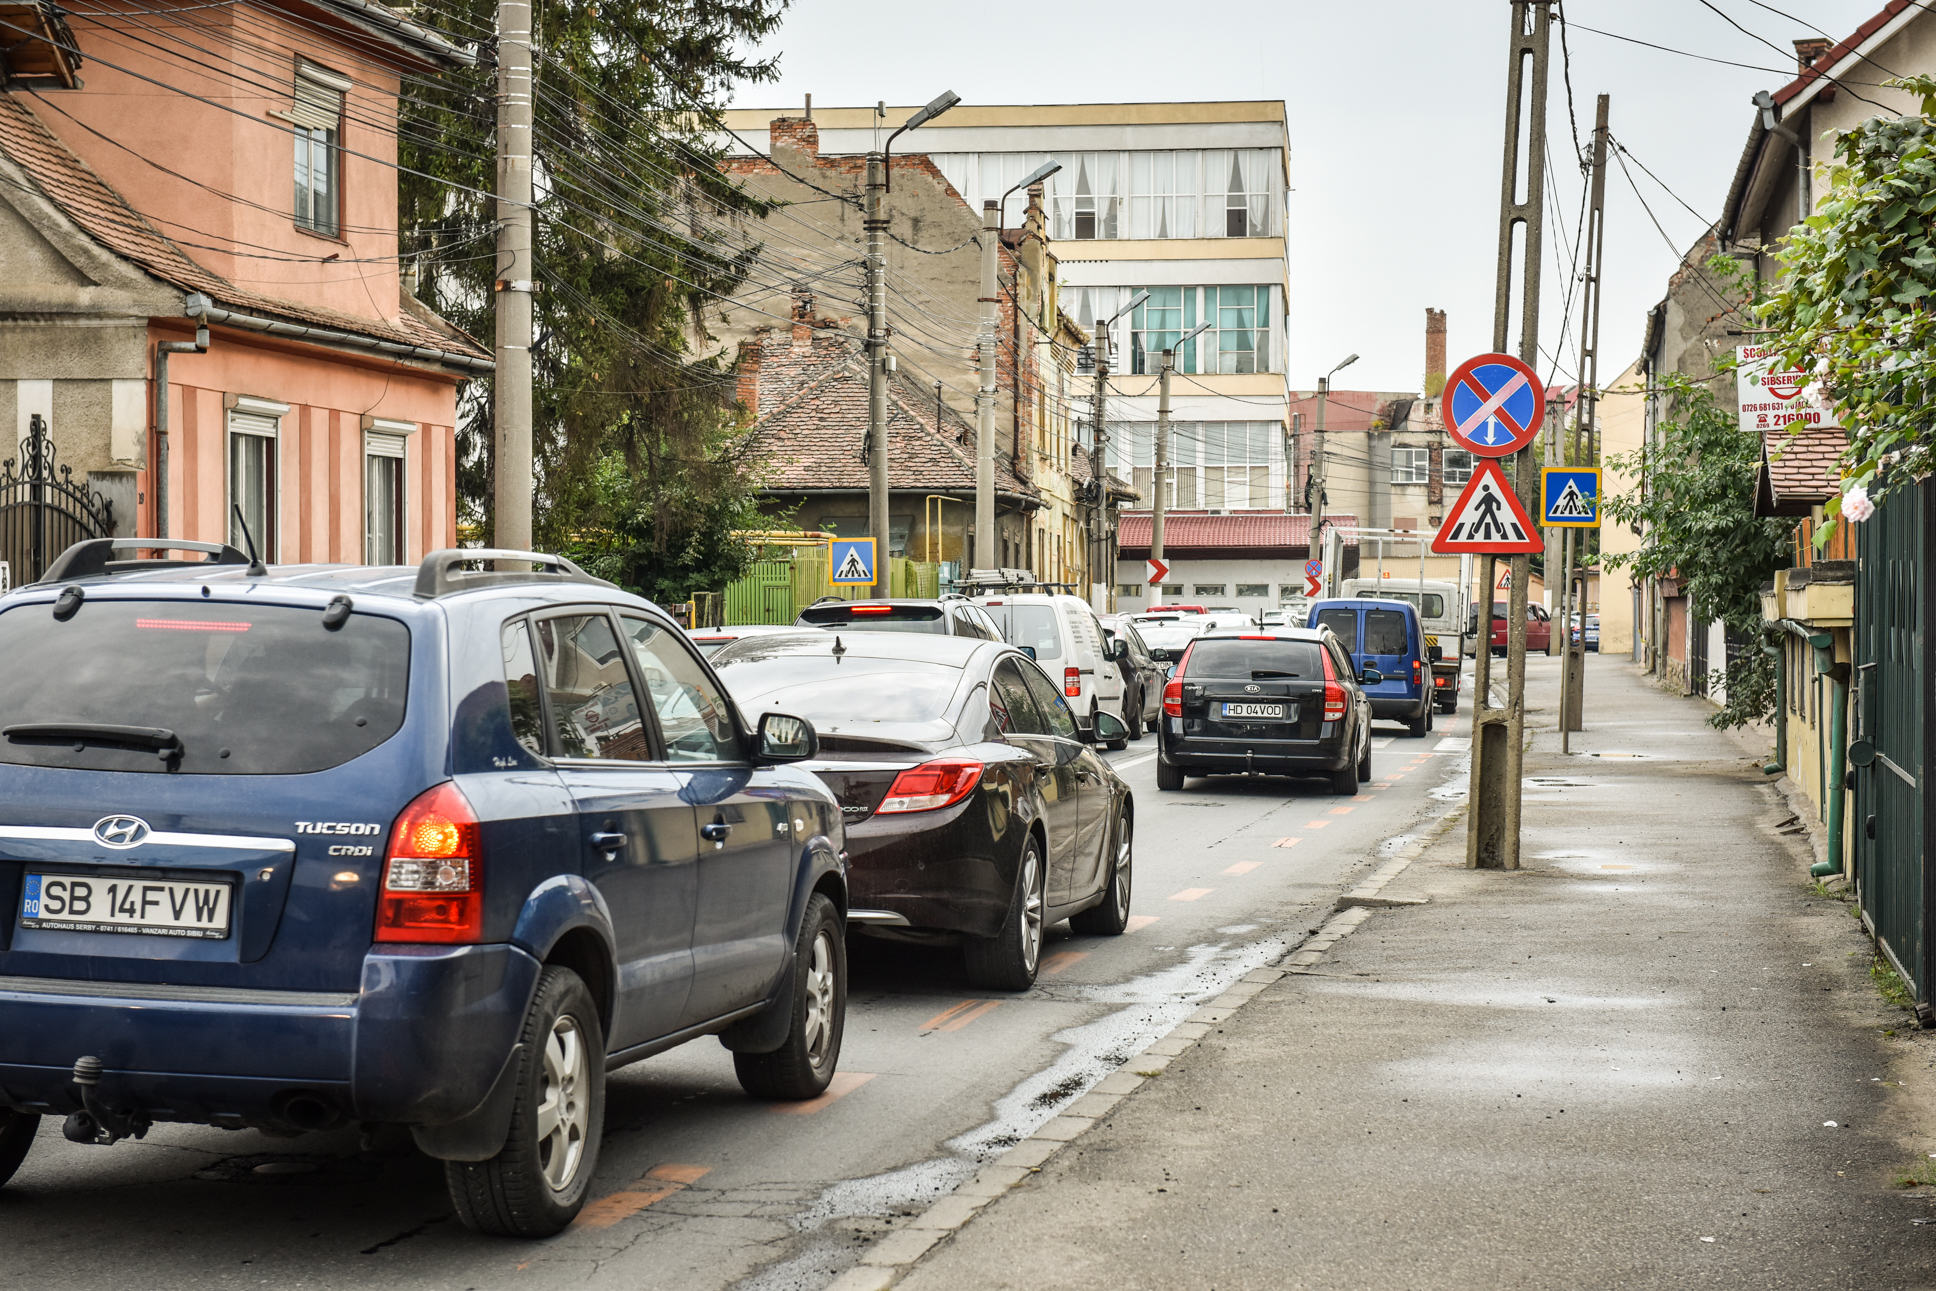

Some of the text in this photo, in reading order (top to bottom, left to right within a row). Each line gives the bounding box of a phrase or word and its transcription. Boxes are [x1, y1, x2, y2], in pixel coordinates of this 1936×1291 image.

[1761, 375, 1806, 386] SIBSERV
[1742, 404, 1758, 412] 0726
[1759, 403, 1770, 411] 681
[1772, 402, 1783, 410] 631
[1228, 705, 1242, 714] HD
[1246, 705, 1281, 716] 04VOD
[294, 821, 381, 836] TUCSON
[328, 845, 374, 857] CRDi
[24, 899, 38, 913] RO
[44, 880, 221, 923] SB 14FVW
